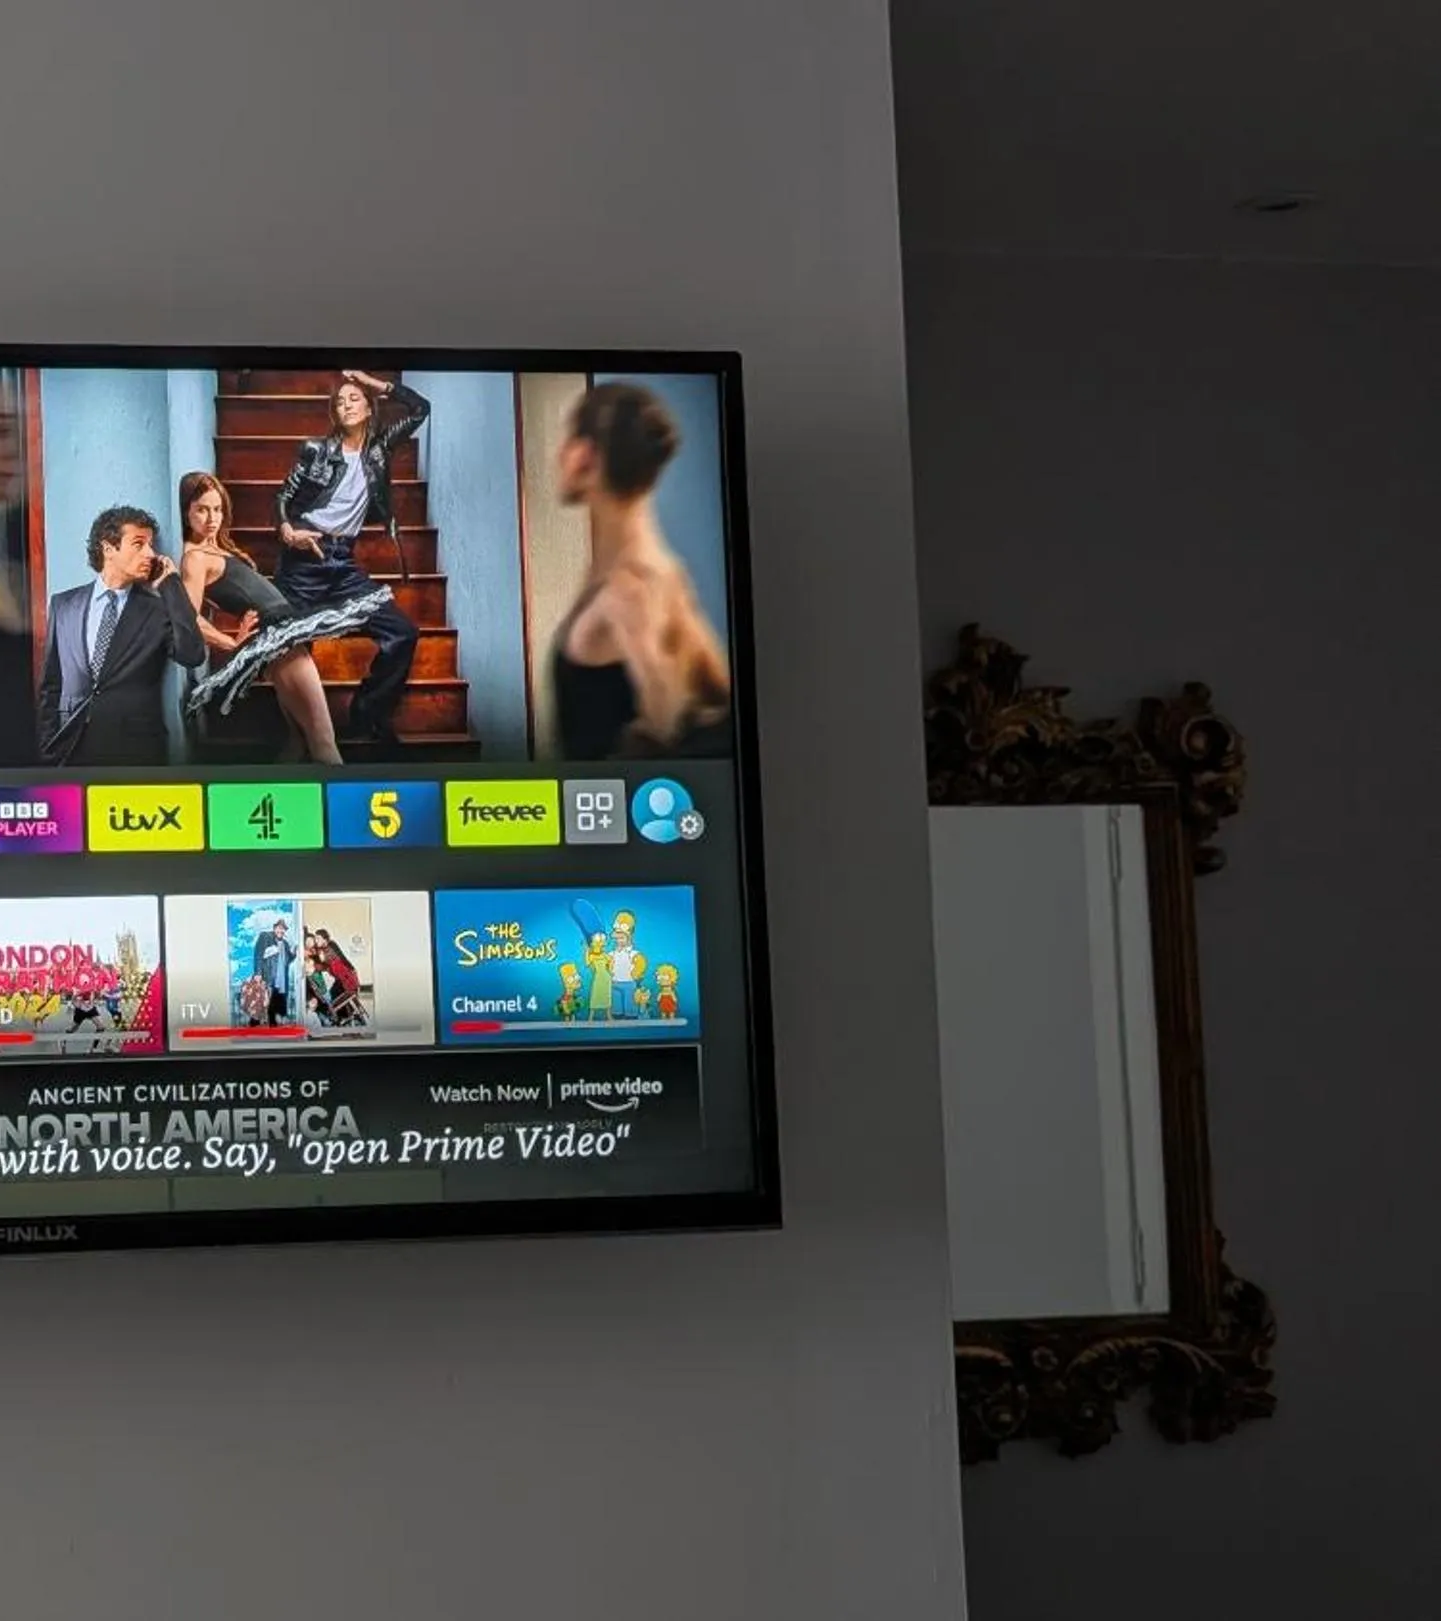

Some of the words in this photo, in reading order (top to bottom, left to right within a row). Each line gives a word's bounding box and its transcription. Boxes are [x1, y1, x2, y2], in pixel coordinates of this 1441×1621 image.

[0, 802, 49, 819] BBC
[248, 792, 283, 841] 4
[369, 791, 403, 839] 5
[458, 797, 547, 826] freevee
[452, 994, 522, 1014] Channel
[526, 995, 539, 1012] 4
[28, 1086, 126, 1105] ANCIENT
[134, 1082, 292, 1103] CIVILIZATIONS
[300, 1080, 331, 1097] OF
[430, 1083, 492, 1103] Watch
[497, 1084, 541, 1101] Now
[561, 1078, 612, 1100] prime
[615, 1076, 663, 1095] video
[162, 1105, 361, 1143] AMERICA
[90, 1135, 193, 1172] voice.
[202, 1135, 277, 1177] Say,
[287, 1132, 390, 1175] "open
[399, 1128, 505, 1165] Prime
[515, 1123, 631, 1161] Video"
